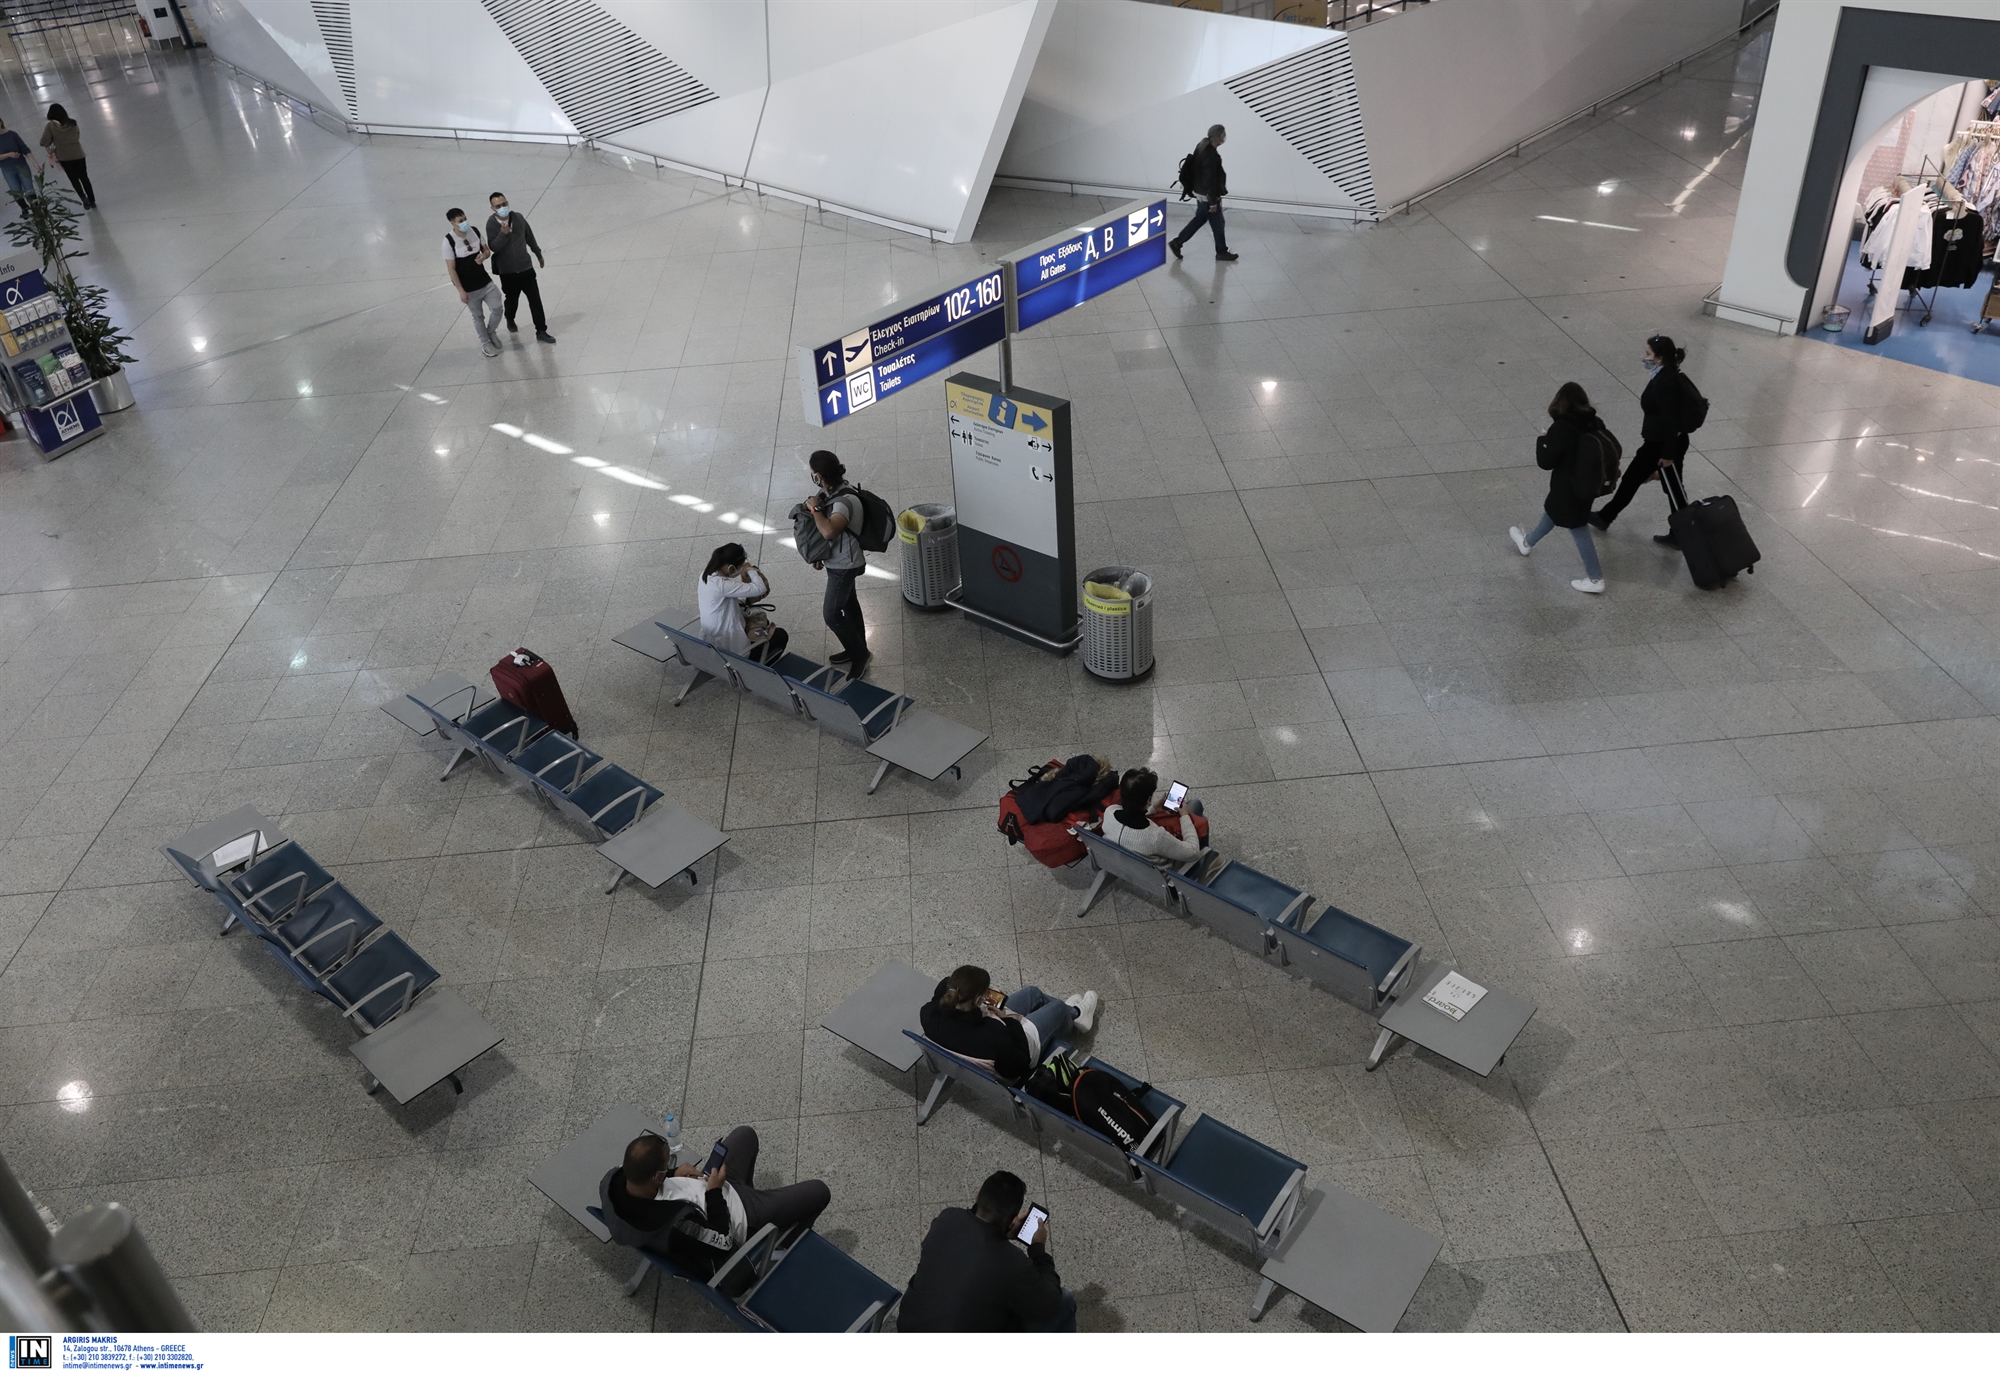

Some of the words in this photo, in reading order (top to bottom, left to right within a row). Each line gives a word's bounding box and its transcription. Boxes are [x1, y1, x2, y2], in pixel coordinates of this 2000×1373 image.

[1299, 15, 1317, 24] Lane
[1040, 253, 1056, 267] Προς
[1058, 241, 1083, 259] Εξόδους
[1104, 226, 1115, 253] B
[1040, 269, 1049, 281] All
[1049, 263, 1067, 277] Gates
[870, 321, 903, 343] Έλεγχος
[903, 303, 941, 329] Εισιτηρίων
[944, 274, 1001, 323] 102-160
[873, 336, 905, 357] Check-in
[877, 353, 916, 378] Τουαλέτες
[853, 381, 870, 398] WC
[879, 376, 902, 393] Toilets
[61, 423, 80, 435] ATHENS
[1097, 1106, 1135, 1145] Admiral
